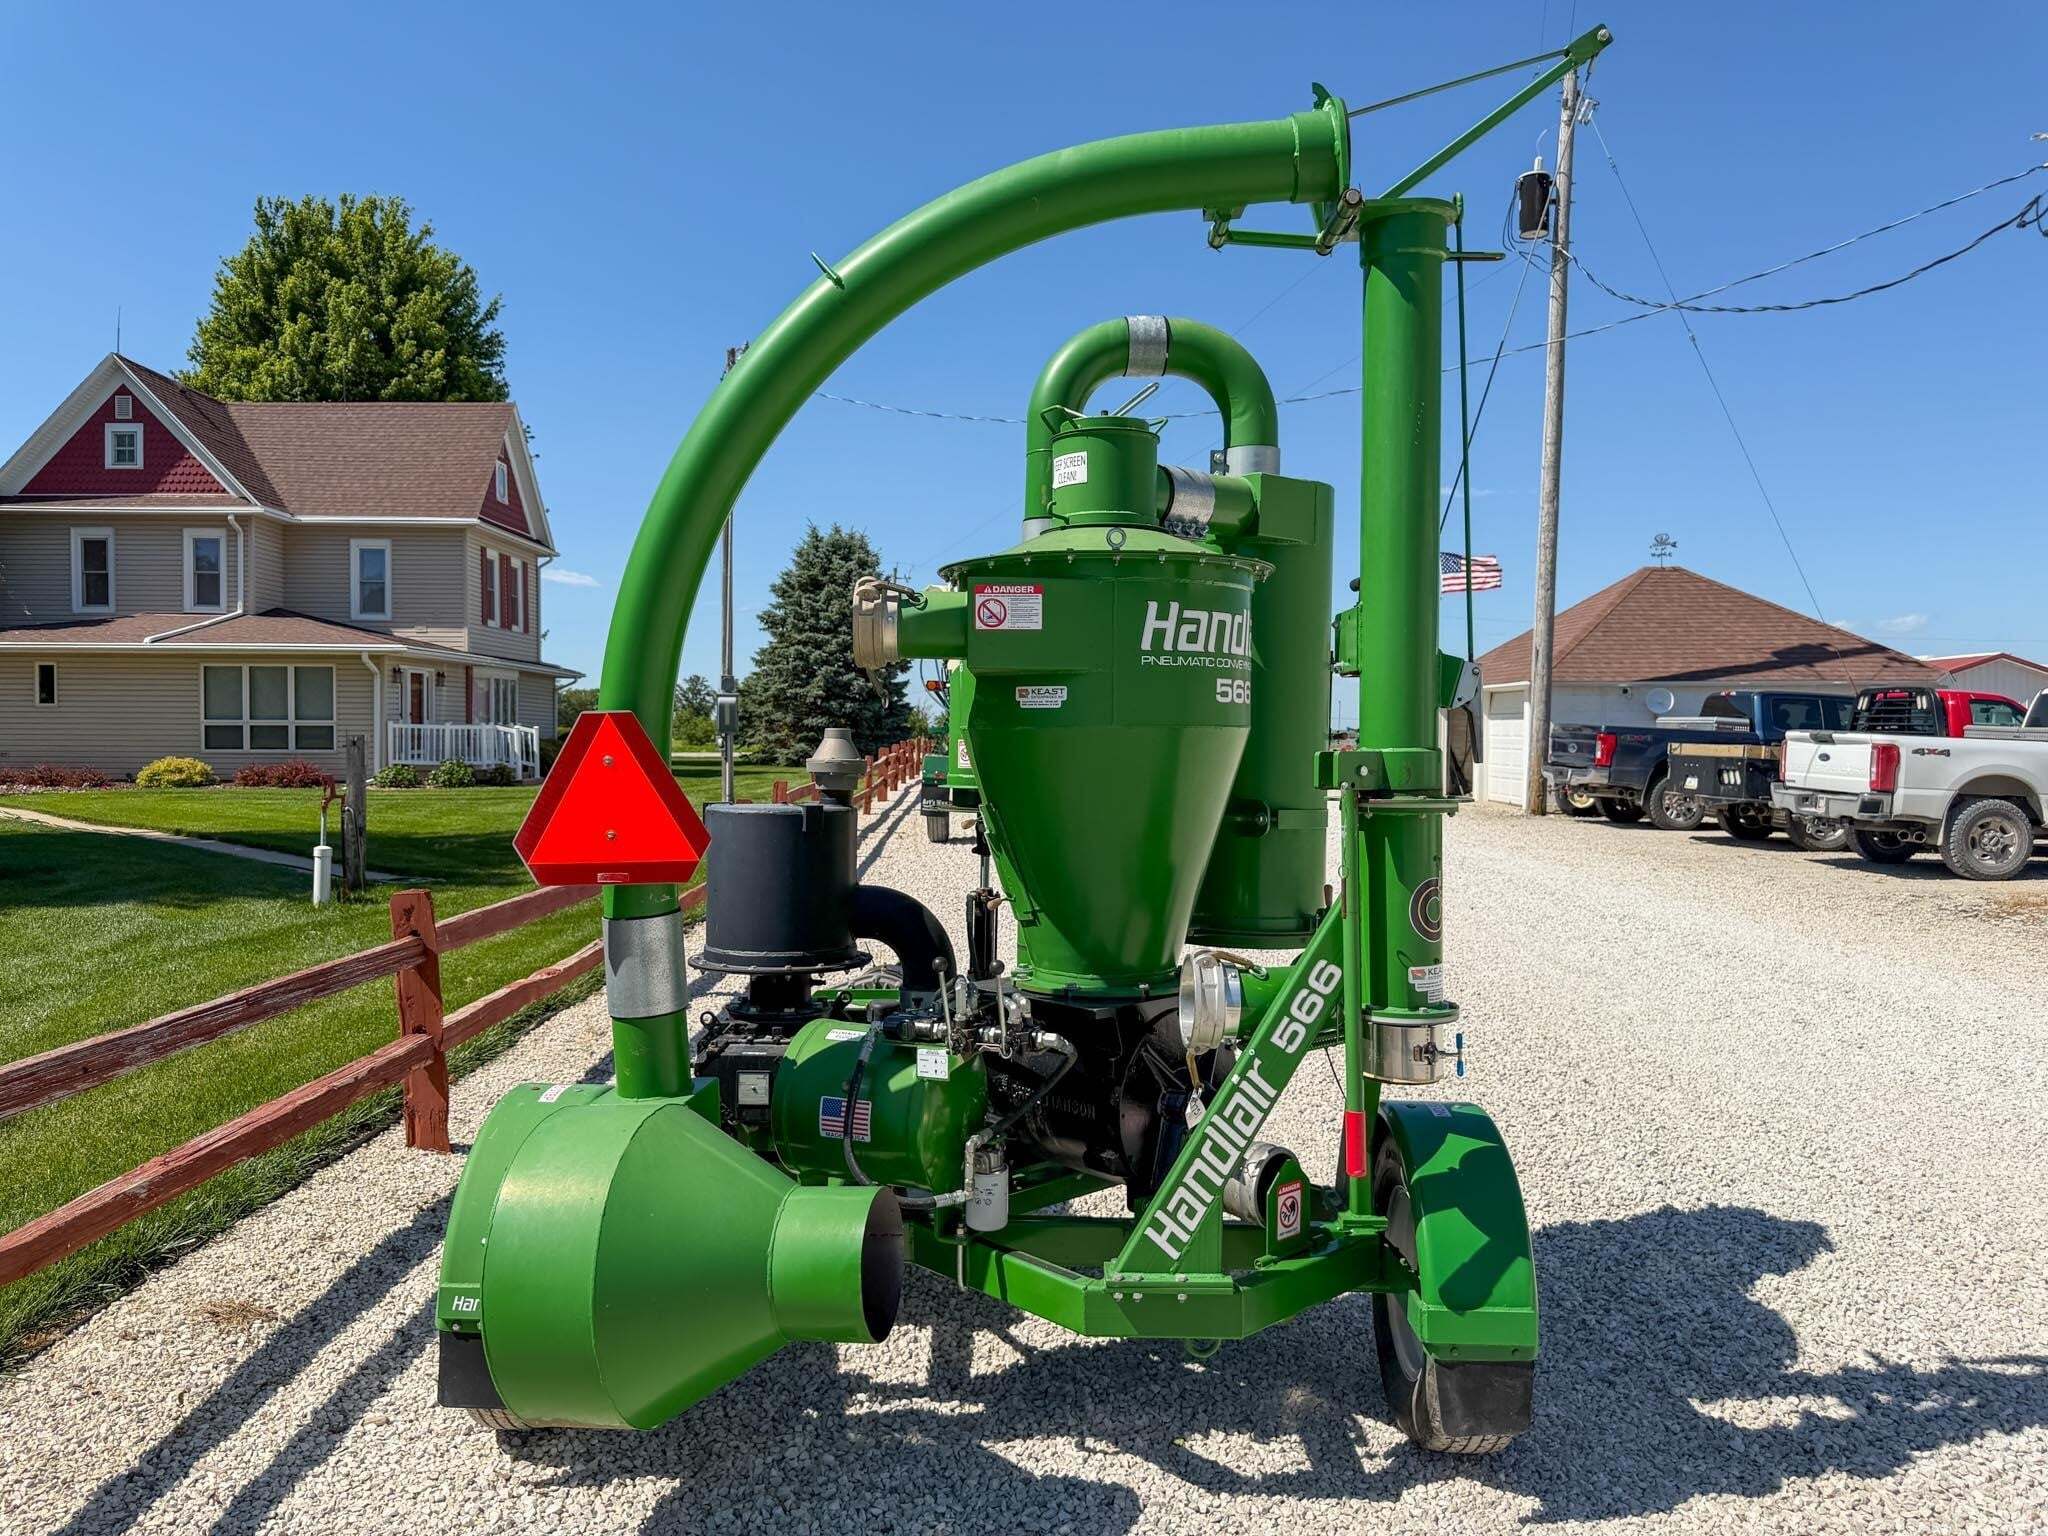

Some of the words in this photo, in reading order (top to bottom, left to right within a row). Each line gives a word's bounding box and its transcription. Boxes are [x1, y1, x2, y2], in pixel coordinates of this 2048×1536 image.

[1063, 455, 1086, 470] SCREEN
[993, 585, 1035, 593] DANGER
[1140, 600, 1252, 656] Handl
[1141, 656, 1215, 667] PNEUMATIC
[1031, 688, 1066, 696] KEAST
[1271, 959, 1343, 1054] 566
[1145, 1057, 1278, 1261] Handlair
